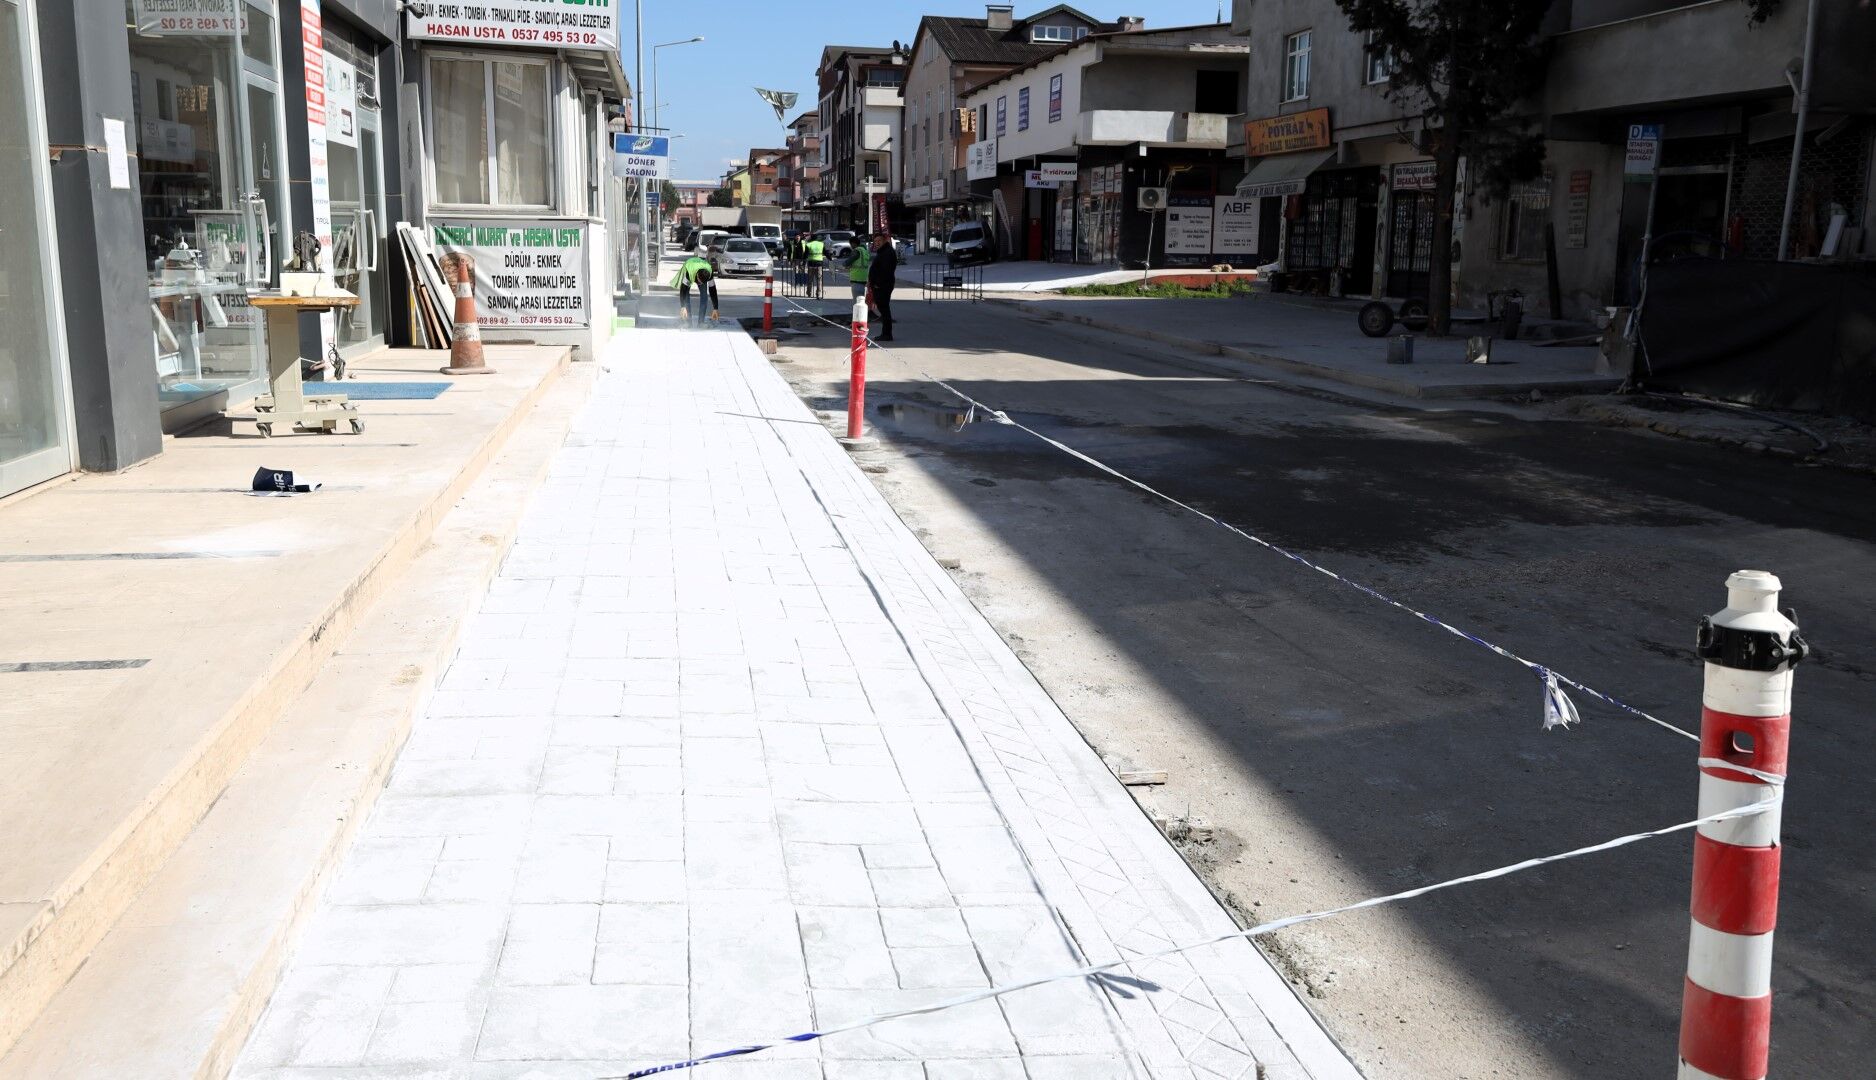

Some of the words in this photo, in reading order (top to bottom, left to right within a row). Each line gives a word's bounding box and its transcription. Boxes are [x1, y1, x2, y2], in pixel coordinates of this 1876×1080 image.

[438, 8, 460, 20] EKMEK
[464, 8, 487, 20] TOMBİK
[517, 6, 530, 24] PİDE
[535, 10, 560, 29] SANDVİÇ
[561, 13, 578, 27] ARASI
[580, 14, 611, 30] LEZZETLER
[427, 24, 470, 37] HASAN
[474, 26, 505, 40] USTA
[512, 28, 539, 41] 0537
[543, 31, 563, 42] 495
[566, 32, 580, 44] 53
[583, 33, 597, 44] 02
[1268, 121, 1304, 138] POYRAZ
[1632, 126, 1640, 138] D
[628, 156, 656, 166] DÖNER
[625, 168, 657, 177] SALONU
[1223, 202, 1252, 214] ABF
[476, 226, 508, 246] MURAT
[510, 232, 521, 247] ve
[523, 228, 553, 247] HASAN
[556, 228, 580, 247] USTA
[505, 251, 531, 268] DÜRÜM
[537, 255, 562, 268] EKMEK
[492, 272, 520, 288] TOMBİK
[526, 276, 558, 288] TIRNAKLI
[560, 272, 576, 288] PİDE
[488, 293, 518, 312] SANDVİÇ
[521, 297, 542, 309] ARASI
[543, 296, 582, 309] LEZZETLER
[520, 316, 537, 324] 0537
[540, 316, 552, 324] 495
[554, 316, 562, 324] 53
